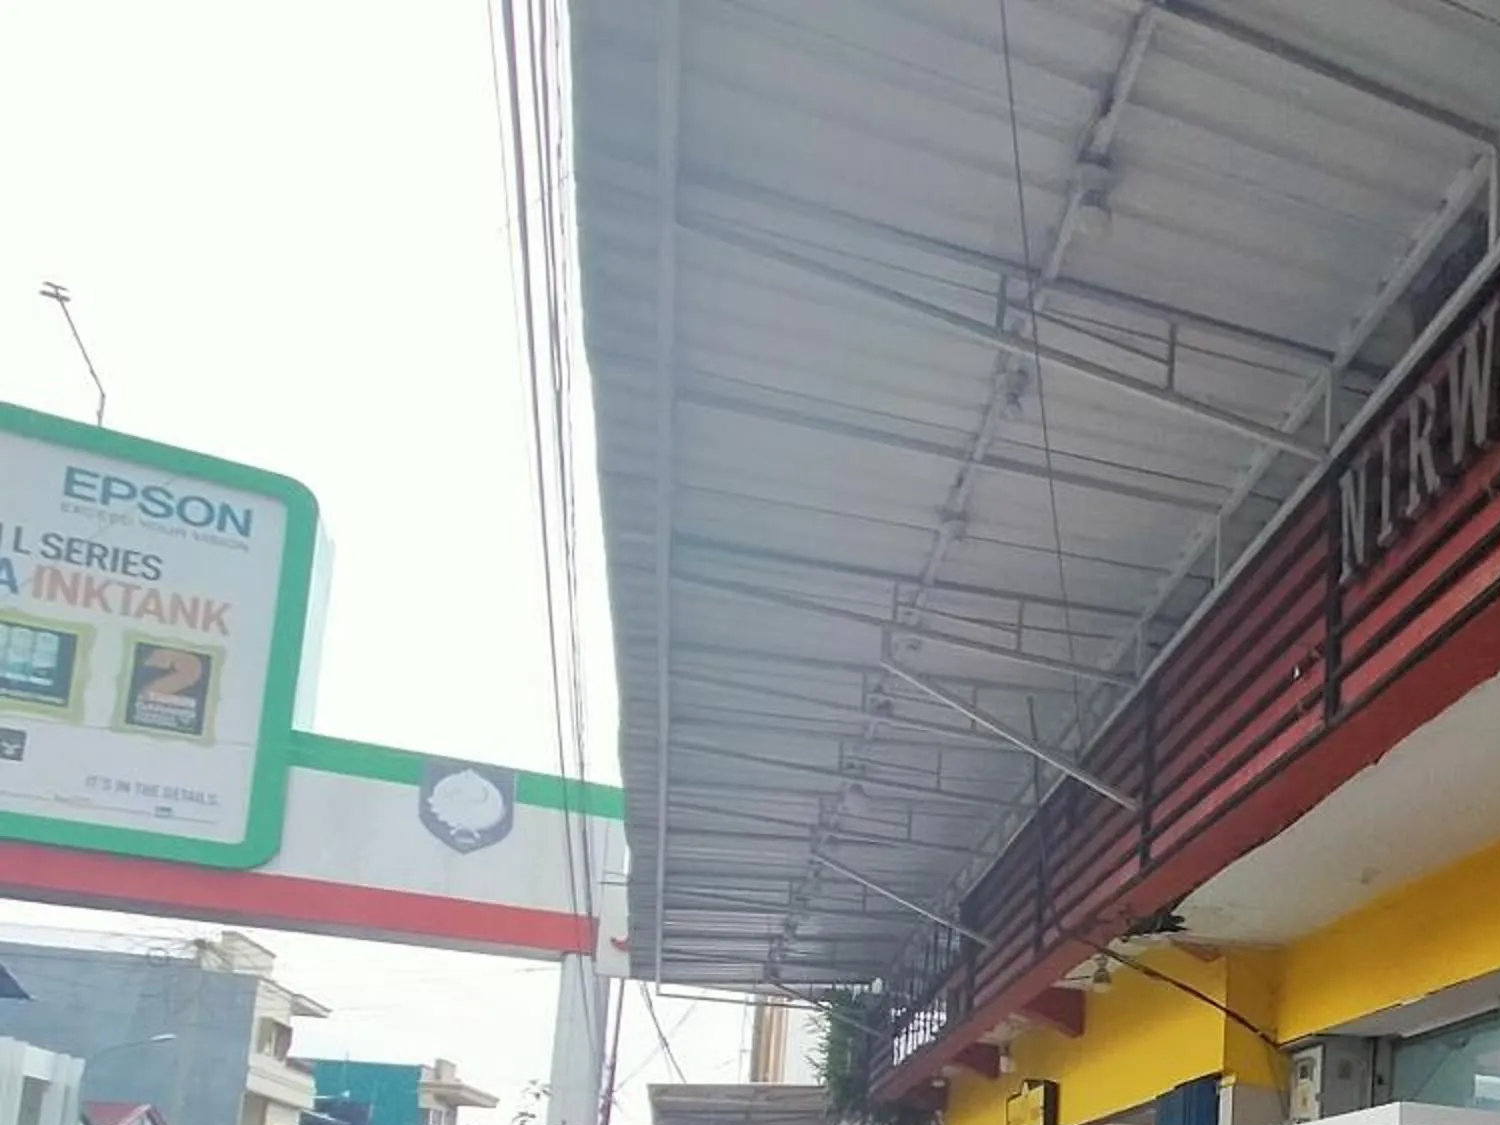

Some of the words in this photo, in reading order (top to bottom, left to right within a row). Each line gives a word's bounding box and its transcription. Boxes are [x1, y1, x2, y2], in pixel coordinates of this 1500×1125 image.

[63, 466, 253, 537] EPSON
[40, 532, 163, 581] SERIES
[31, 564, 232, 636] INKTANK
